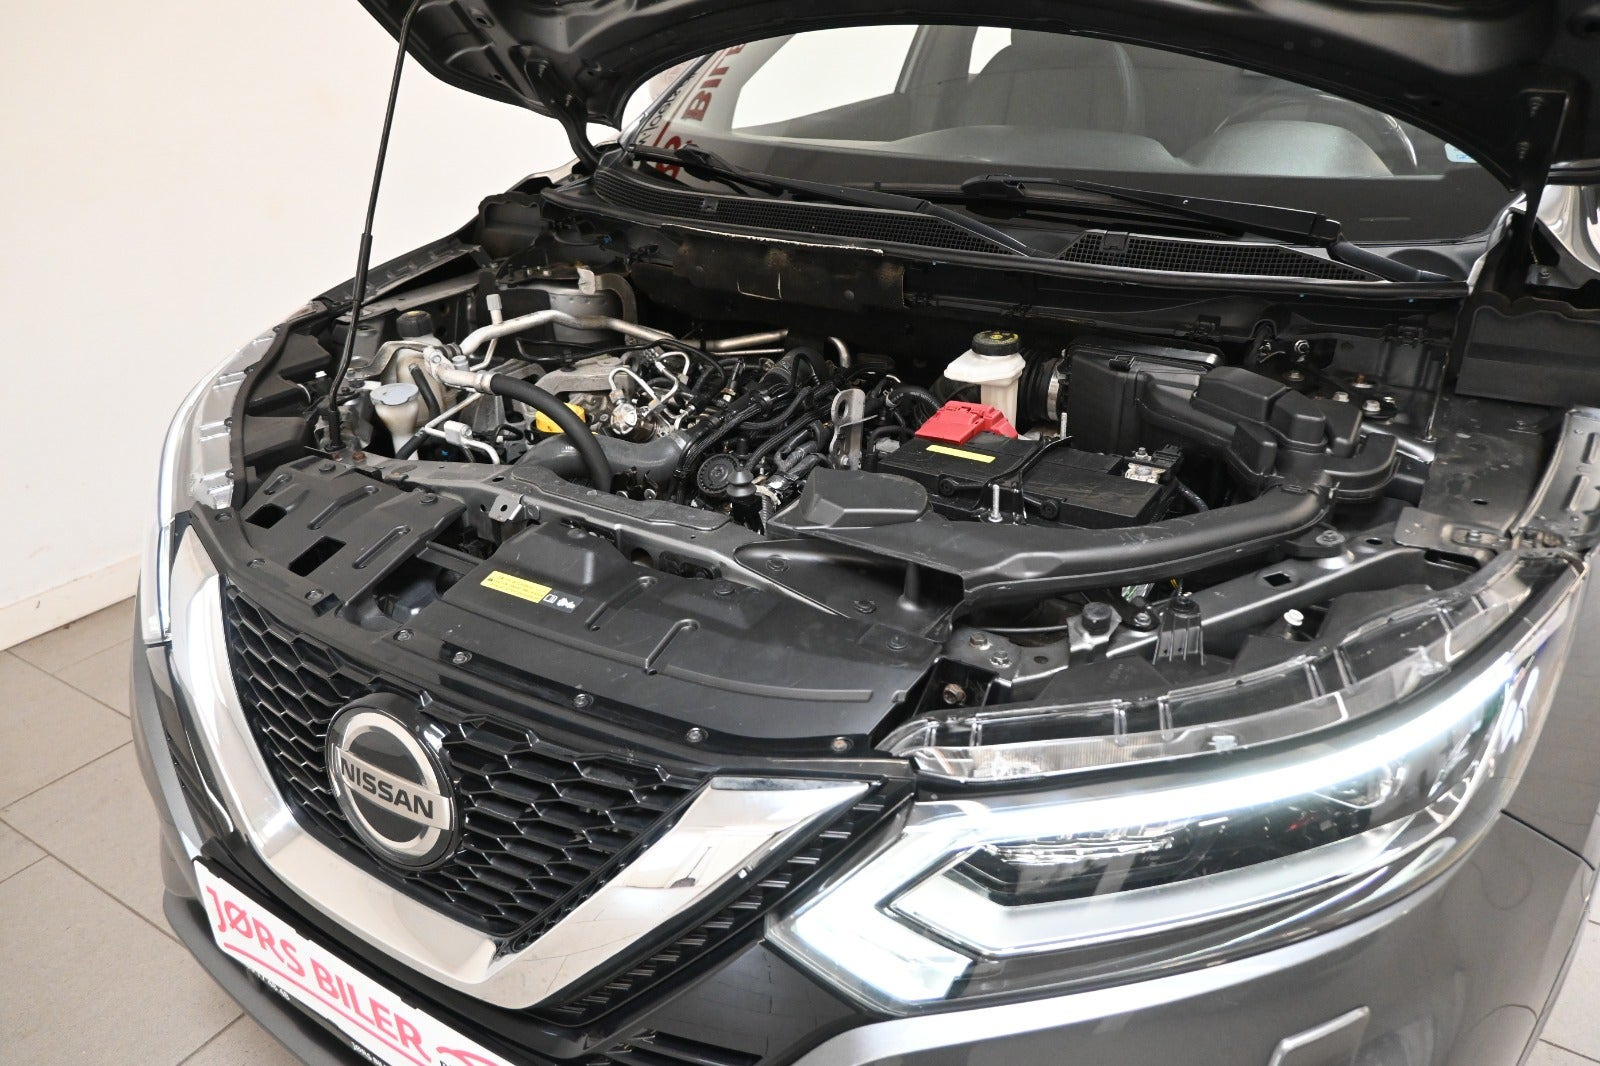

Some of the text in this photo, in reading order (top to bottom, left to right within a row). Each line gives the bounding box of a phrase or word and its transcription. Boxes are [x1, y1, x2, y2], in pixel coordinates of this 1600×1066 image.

[341, 757, 433, 819] NISSAN
[206, 885, 432, 1063] JØRS BILER
